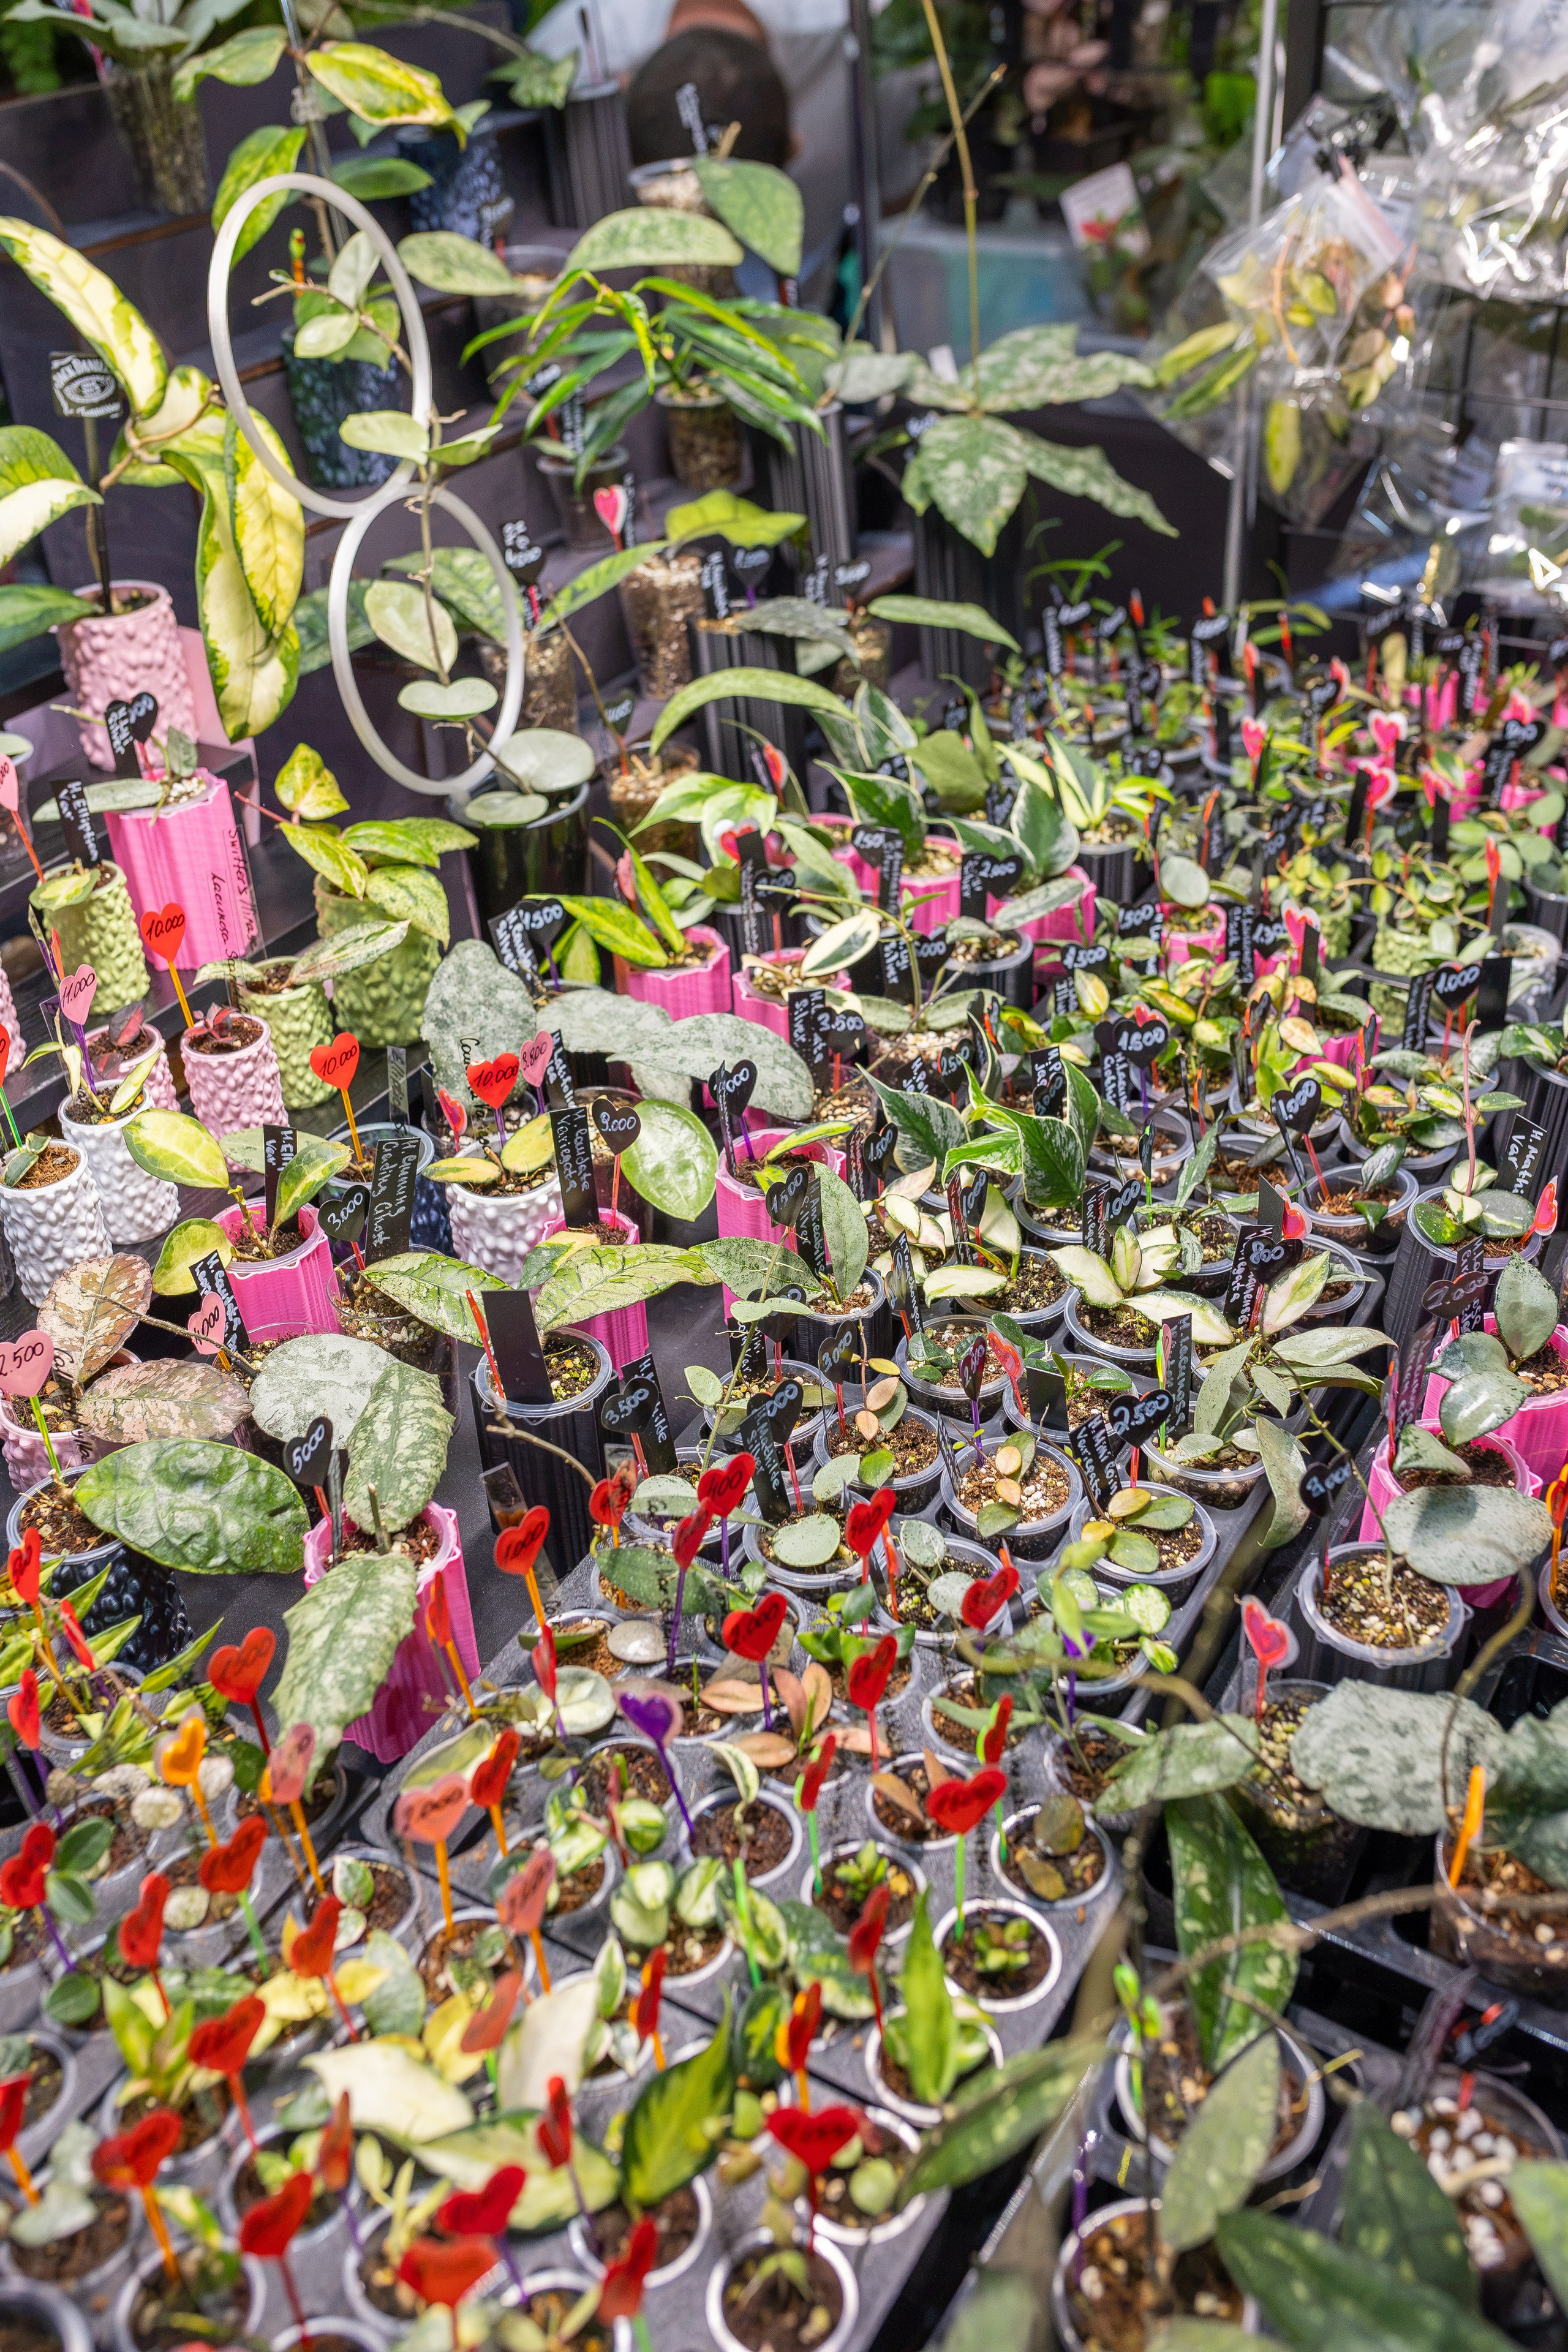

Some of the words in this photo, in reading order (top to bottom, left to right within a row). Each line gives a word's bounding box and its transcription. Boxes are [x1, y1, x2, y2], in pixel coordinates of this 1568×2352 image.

[146, 914, 184, 941] 10.000
[62, 973, 95, 1008] 11.000
[1436, 965, 1480, 993] 1.000
[817, 1012, 864, 1031] 3.500
[319, 1045, 361, 1076] 10.000
[474, 1065, 519, 1088] 10.000
[1508, 1135, 1526, 1170] Var
[772, 1173, 802, 1213] 1.500
[963, 1172, 986, 1218] 1.000
[1104, 1180, 1140, 1221] 1.000
[327, 1192, 363, 1232] 3.000
[1250, 1241, 1284, 1264] 800
[605, 1388, 649, 1424] 3.500
[1113, 1394, 1169, 1436] 2.500
